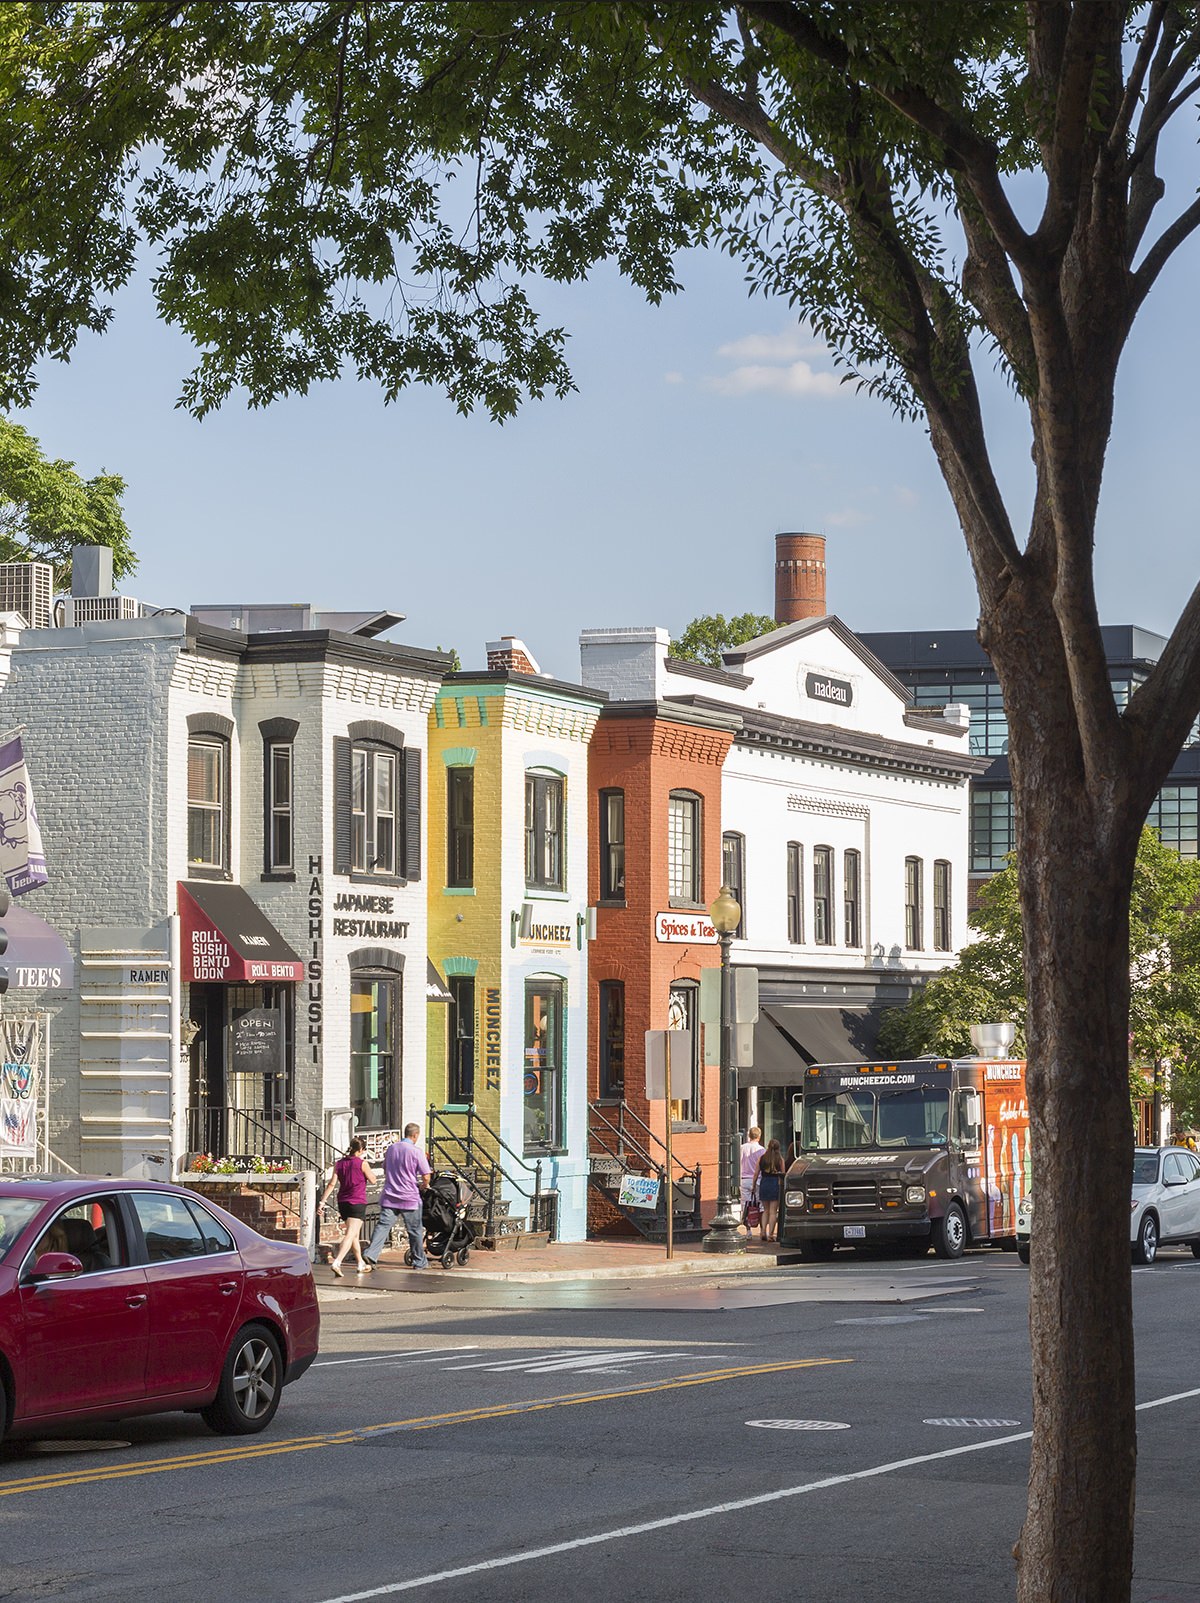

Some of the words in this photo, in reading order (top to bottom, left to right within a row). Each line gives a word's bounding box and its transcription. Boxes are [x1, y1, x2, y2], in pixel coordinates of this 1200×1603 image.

[814, 680, 847, 702] nadeau
[333, 893, 394, 914] JAPANESE
[333, 918, 410, 939] RESTAURANT
[520, 924, 571, 942] UNCHEEZ
[660, 918, 689, 940] Spices
[690, 924, 696, 935] &
[697, 921, 715, 937] Teas
[192, 930, 220, 943] ROLL
[239, 934, 270, 946] RAMEN
[192, 943, 228, 955] SUSHI
[193, 955, 230, 968] BENTO
[130, 970, 169, 982] RAMEN
[193, 967, 224, 979] UDON
[251, 964, 269, 977] ROLL
[271, 965, 294, 977] BENTO
[16, 967, 61, 988] TEE'S
[240, 1018, 272, 1028] OPEN
[486, 987, 500, 1091] MUNCHEEZ
[840, 1074, 915, 1086] MUNCHEEZDC.COM
